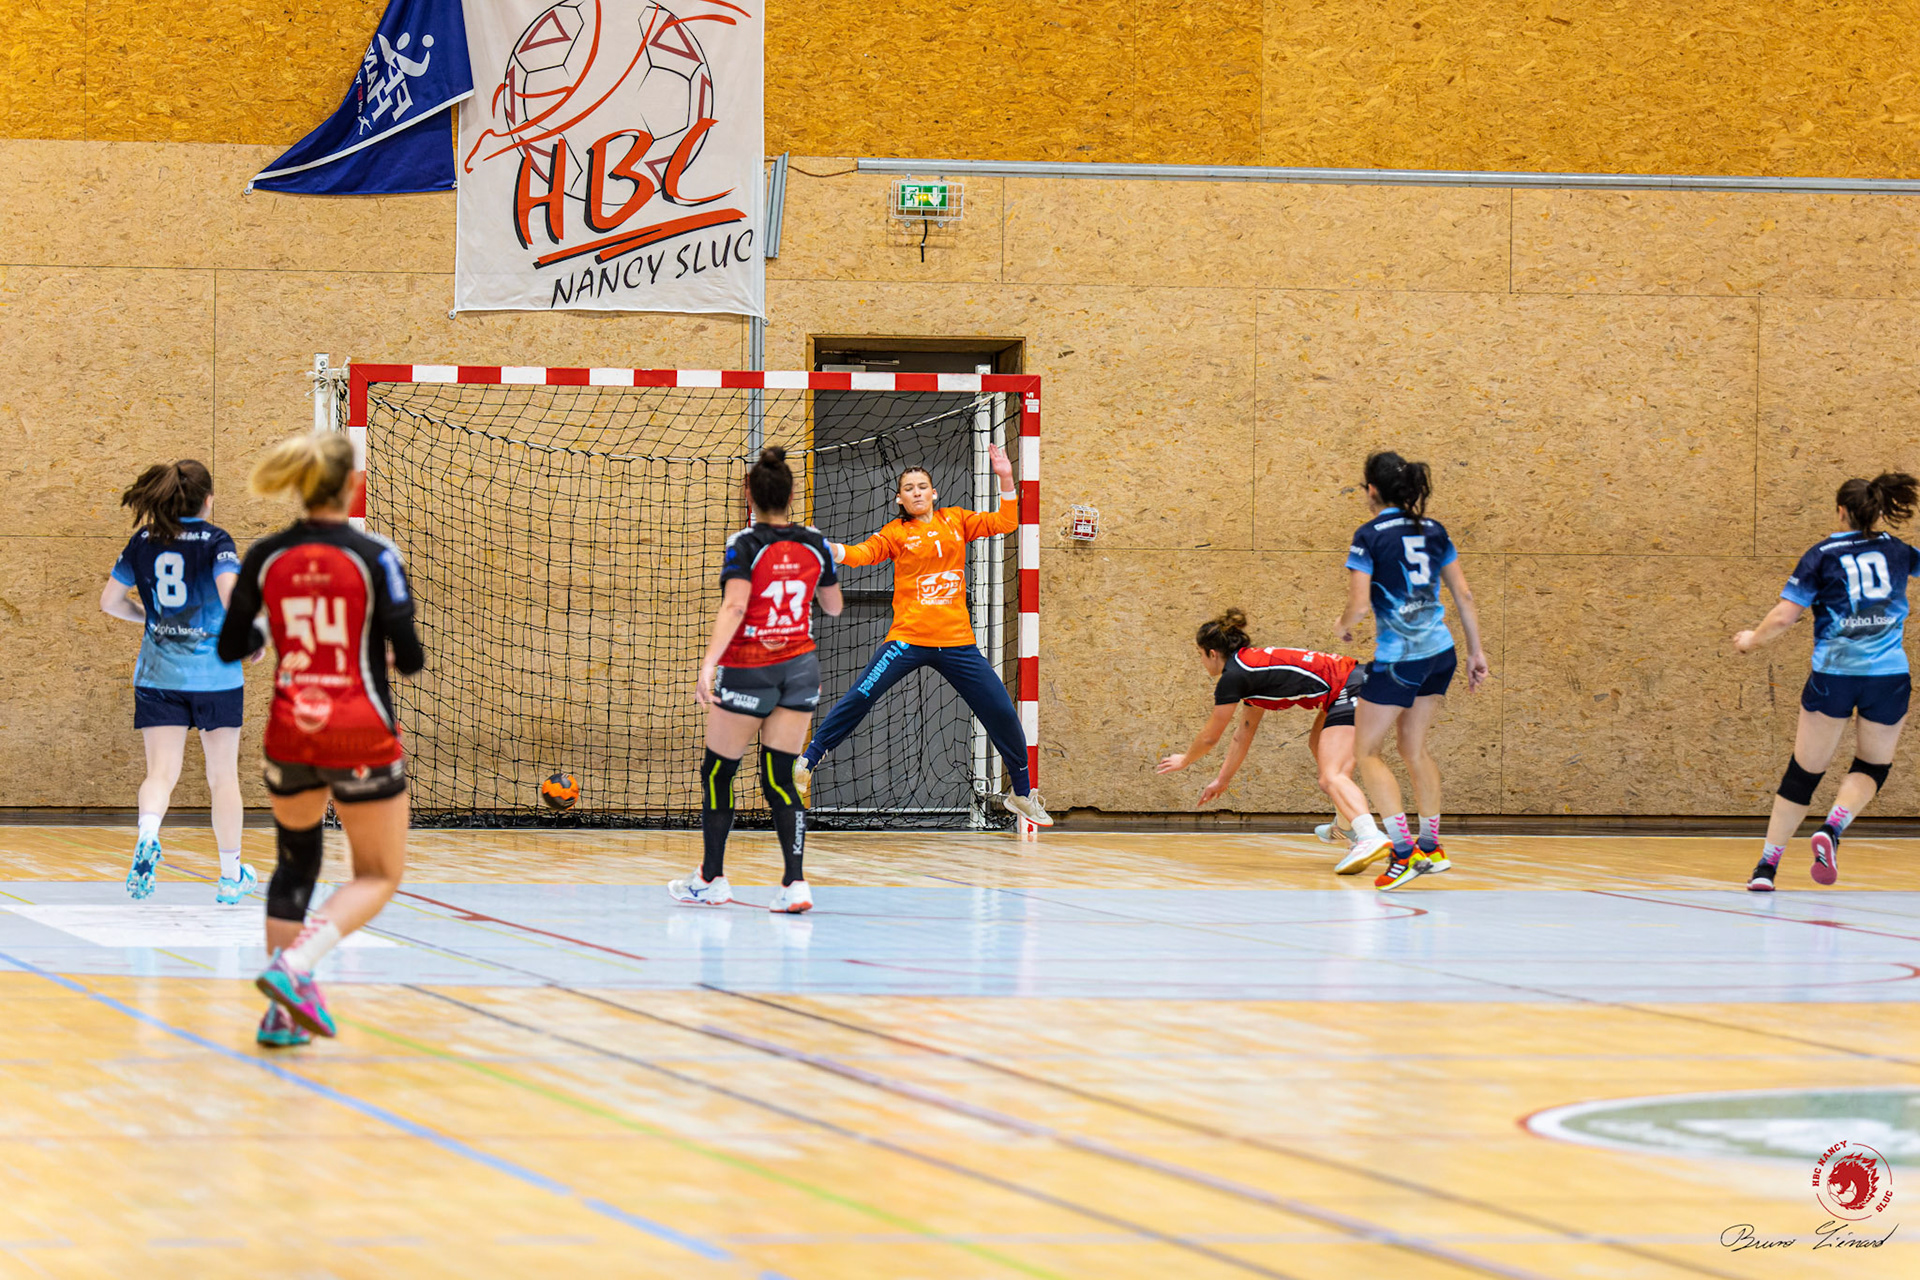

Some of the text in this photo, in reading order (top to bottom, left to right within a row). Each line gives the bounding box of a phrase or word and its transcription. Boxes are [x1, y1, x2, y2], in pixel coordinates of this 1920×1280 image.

[513, 117, 737, 250] HBC
[551, 228, 754, 309] NANCY SLUC
[154, 551, 188, 608] 8
[1402, 535, 1431, 585] 5
[1839, 551, 1893, 600] 10
[280, 596, 349, 673] 54
[1840, 615, 1871, 628] alpha
[793, 811, 806, 855] Kempa
